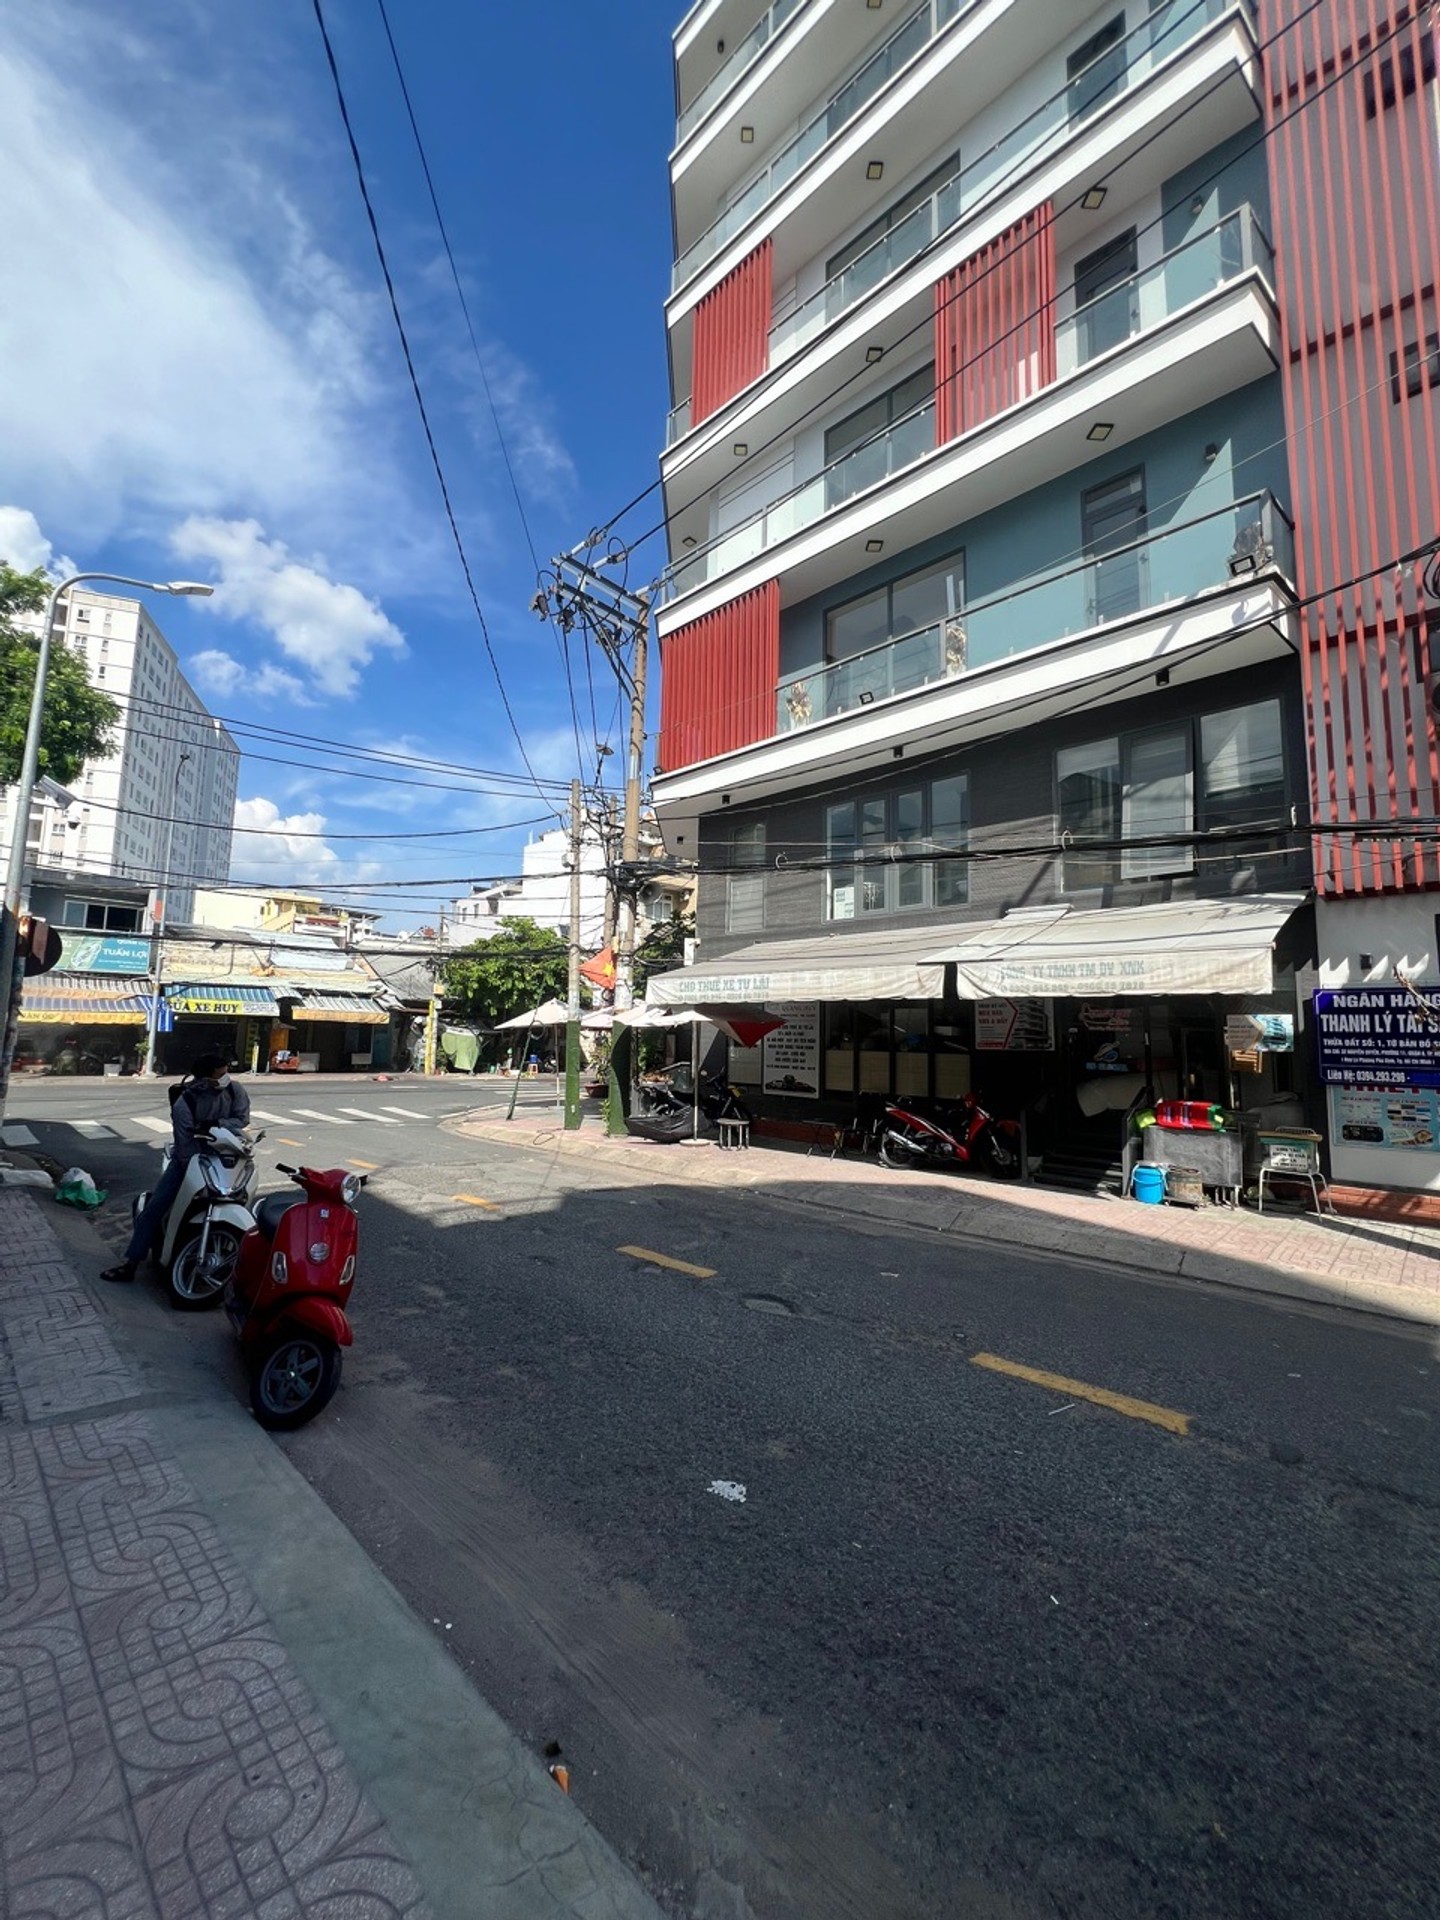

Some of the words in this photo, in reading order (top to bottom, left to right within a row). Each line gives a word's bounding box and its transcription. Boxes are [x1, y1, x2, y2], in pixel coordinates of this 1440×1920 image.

[722, 979, 735, 991] XE
[1333, 992, 1385, 1008] NGÂN
[1390, 991, 1440, 1008] HÀNG
[194, 1002, 211, 1012] XE
[213, 1003, 239, 1013] HUY
[1320, 1014, 1370, 1032] THANH
[1374, 1010, 1393, 1033] LÝ
[1396, 1010, 1424, 1033] TÀI
[1327, 1069, 1342, 1080] Liên
